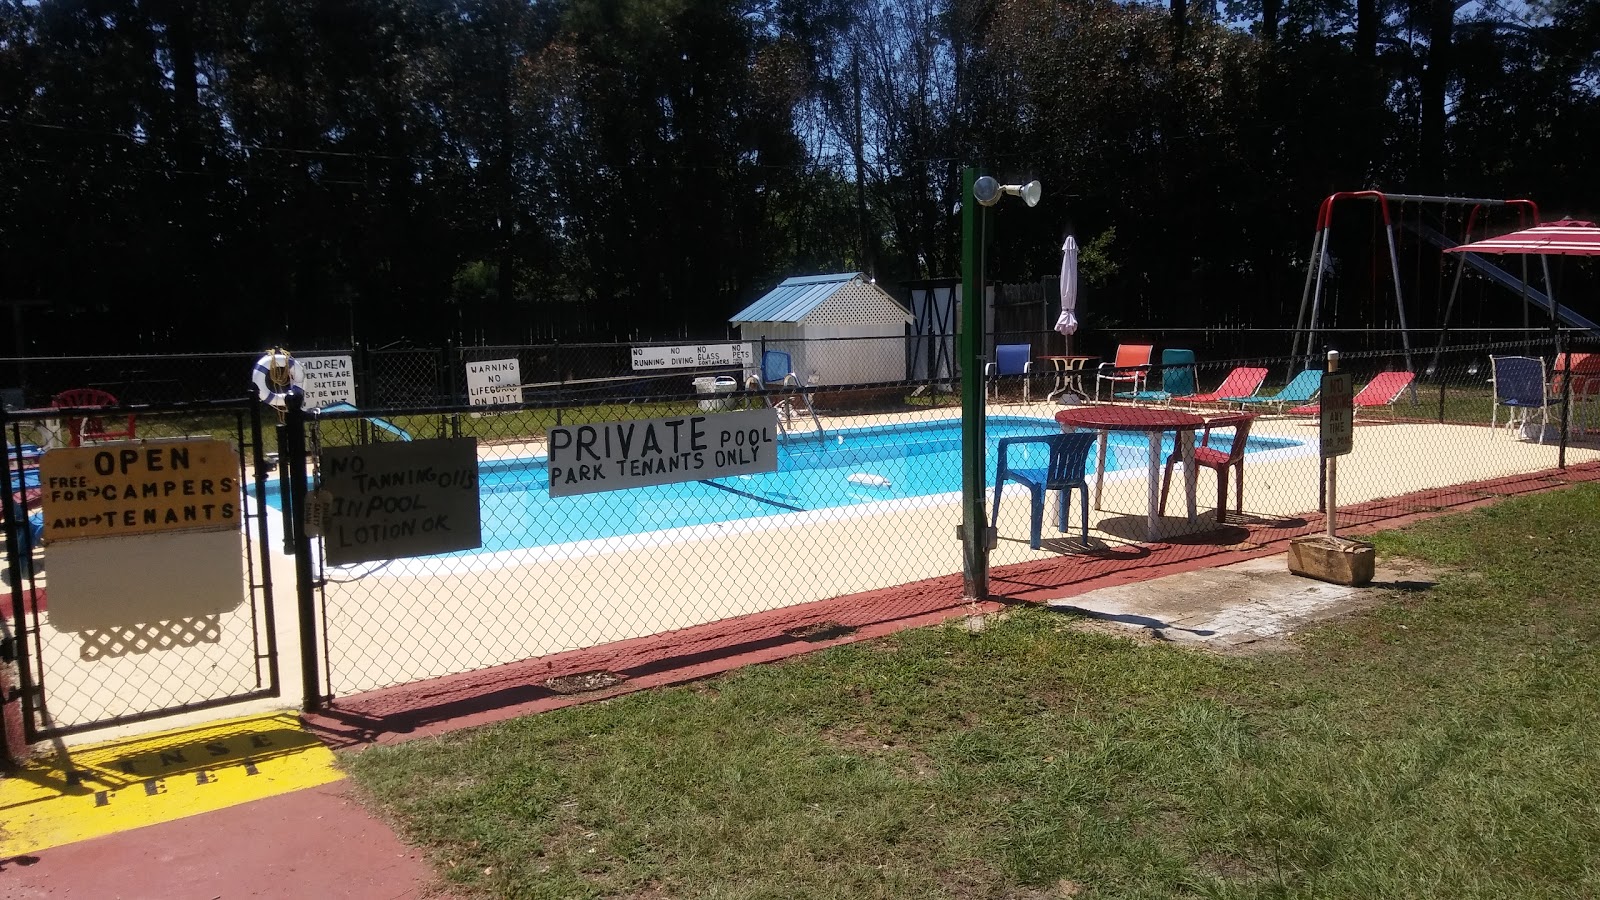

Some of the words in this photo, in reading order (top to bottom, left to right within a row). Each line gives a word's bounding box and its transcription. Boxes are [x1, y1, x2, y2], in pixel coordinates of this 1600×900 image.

[697, 346, 707, 354] NO
[698, 353, 720, 361] GLASS
[304, 360, 346, 370] HILDREN
[470, 362, 514, 373] WARNING
[634, 358, 665, 367] RUNNING
[672, 357, 694, 365] DIVING
[488, 374, 501, 383] NO
[1330, 378, 1344, 393] NO
[316, 399, 347, 408] ADUT
[474, 398, 487, 406] ON
[493, 395, 517, 405] DUTY
[1323, 393, 1351, 413] PARKING
[1330, 412, 1343, 422] ANY
[1330, 422, 1344, 434] TIME
[550, 416, 708, 462] PRIVATE
[720, 427, 772, 448] POOL
[94, 447, 190, 475] OPEN
[331, 456, 364, 476] NO
[551, 464, 606, 486] PARK
[616, 452, 704, 476] TENANTS
[715, 446, 759, 468] ONLY
[49, 476, 87, 489] FREE
[352, 467, 436, 494] TANNING
[51, 490, 88, 503] FOR
[102, 477, 233, 500] CAMPERS
[332, 498, 362, 517] IN
[366, 494, 427, 518] POOL
[52, 516, 87, 529] AND
[103, 503, 234, 527] TENANTS
[422, 514, 450, 532] OK
[93, 757, 262, 807] FEET
